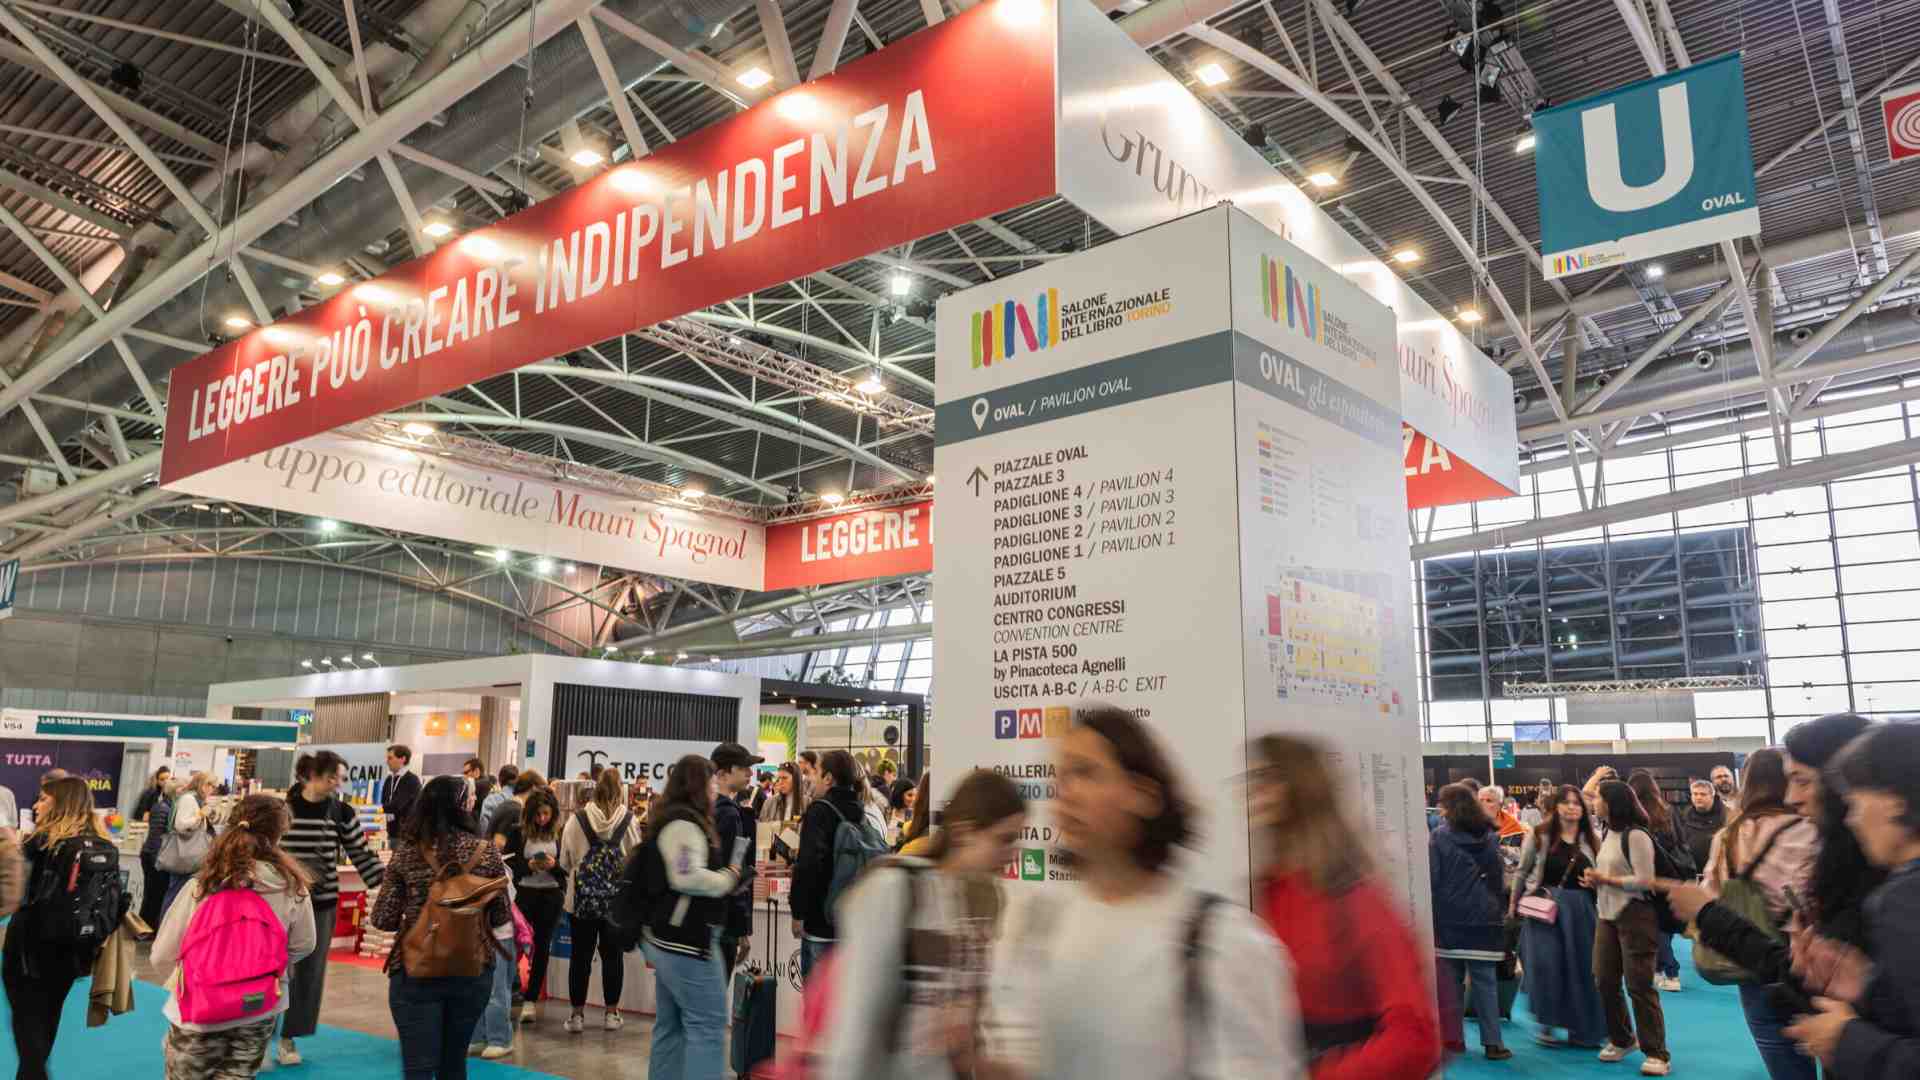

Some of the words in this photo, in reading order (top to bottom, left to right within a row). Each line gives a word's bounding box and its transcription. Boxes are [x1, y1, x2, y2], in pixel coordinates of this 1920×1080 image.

[1581, 81, 1695, 213] U
[1701, 192, 1745, 212] OVAL
[188, 349, 301, 442] LEGGERE
[309, 306, 371, 398] PUÒ
[379, 258, 525, 370] CREARE
[534, 88, 938, 315] INDIPENDENZA
[1061, 292, 1108, 317] SALONE
[1061, 287, 1171, 329] INTERNAZIONALE
[1061, 325, 1083, 341] DEL
[1085, 314, 1123, 338] LIBRO
[1126, 303, 1172, 323] TORINO
[1259, 350, 1306, 396] OVAL
[993, 403, 1025, 421] OVAL
[1040, 387, 1096, 412] PAVILION
[1099, 376, 1133, 398] OVAL
[994, 452, 1053, 475] PIAZZALE
[1056, 445, 1088, 464] OVAL
[994, 471, 1053, 494] PIAZZALE
[1056, 468, 1065, 482] 3
[994, 487, 1070, 513] PADIGLIONE
[1073, 485, 1082, 499] 4
[1100, 471, 1161, 494] PAVILION
[1164, 468, 1174, 482] 4
[262, 446, 367, 494] uppo
[377, 459, 540, 520] editoriale
[545, 488, 638, 539] Mauri
[642, 511, 749, 564] Spagnol
[994, 506, 1070, 532] PADIGLIONE
[1074, 504, 1083, 518] 3
[1100, 490, 1162, 514] PAVILION
[1165, 488, 1175, 503] 3
[801, 503, 920, 563] LEGGERE
[994, 526, 1070, 550] PADIGLIONE
[1074, 524, 1083, 538] 2
[1101, 512, 1162, 534] PAVILION
[1165, 510, 1176, 525] 2
[994, 545, 1070, 569] PADIGLIONE
[1074, 544, 1083, 558] 1
[1101, 533, 1162, 553] PAVILION
[1167, 531, 1176, 546] 1
[994, 568, 1054, 588] PIAZZALE
[1057, 566, 1066, 580] 5
[993, 585, 1077, 607] AUDITORIUM
[993, 608, 1044, 626] CENTRO
[1047, 600, 1125, 621] CONGRESSI
[993, 623, 1070, 644] CONVENTION
[1073, 618, 1125, 637] CENTRE
[994, 649, 1009, 663] LA
[1012, 646, 1048, 661] PISTA
[1052, 643, 1077, 658] 500
[994, 666, 1008, 682] by
[1010, 662, 1078, 680] Pinacoteca
[1081, 657, 1126, 676] Agnelli
[994, 684, 1039, 700] USCITA
[1135, 675, 1167, 692] EXIT
[5, 753, 52, 766] TUTTA
[993, 763, 1056, 778] GALLERIA
[1043, 827, 1052, 841] D
